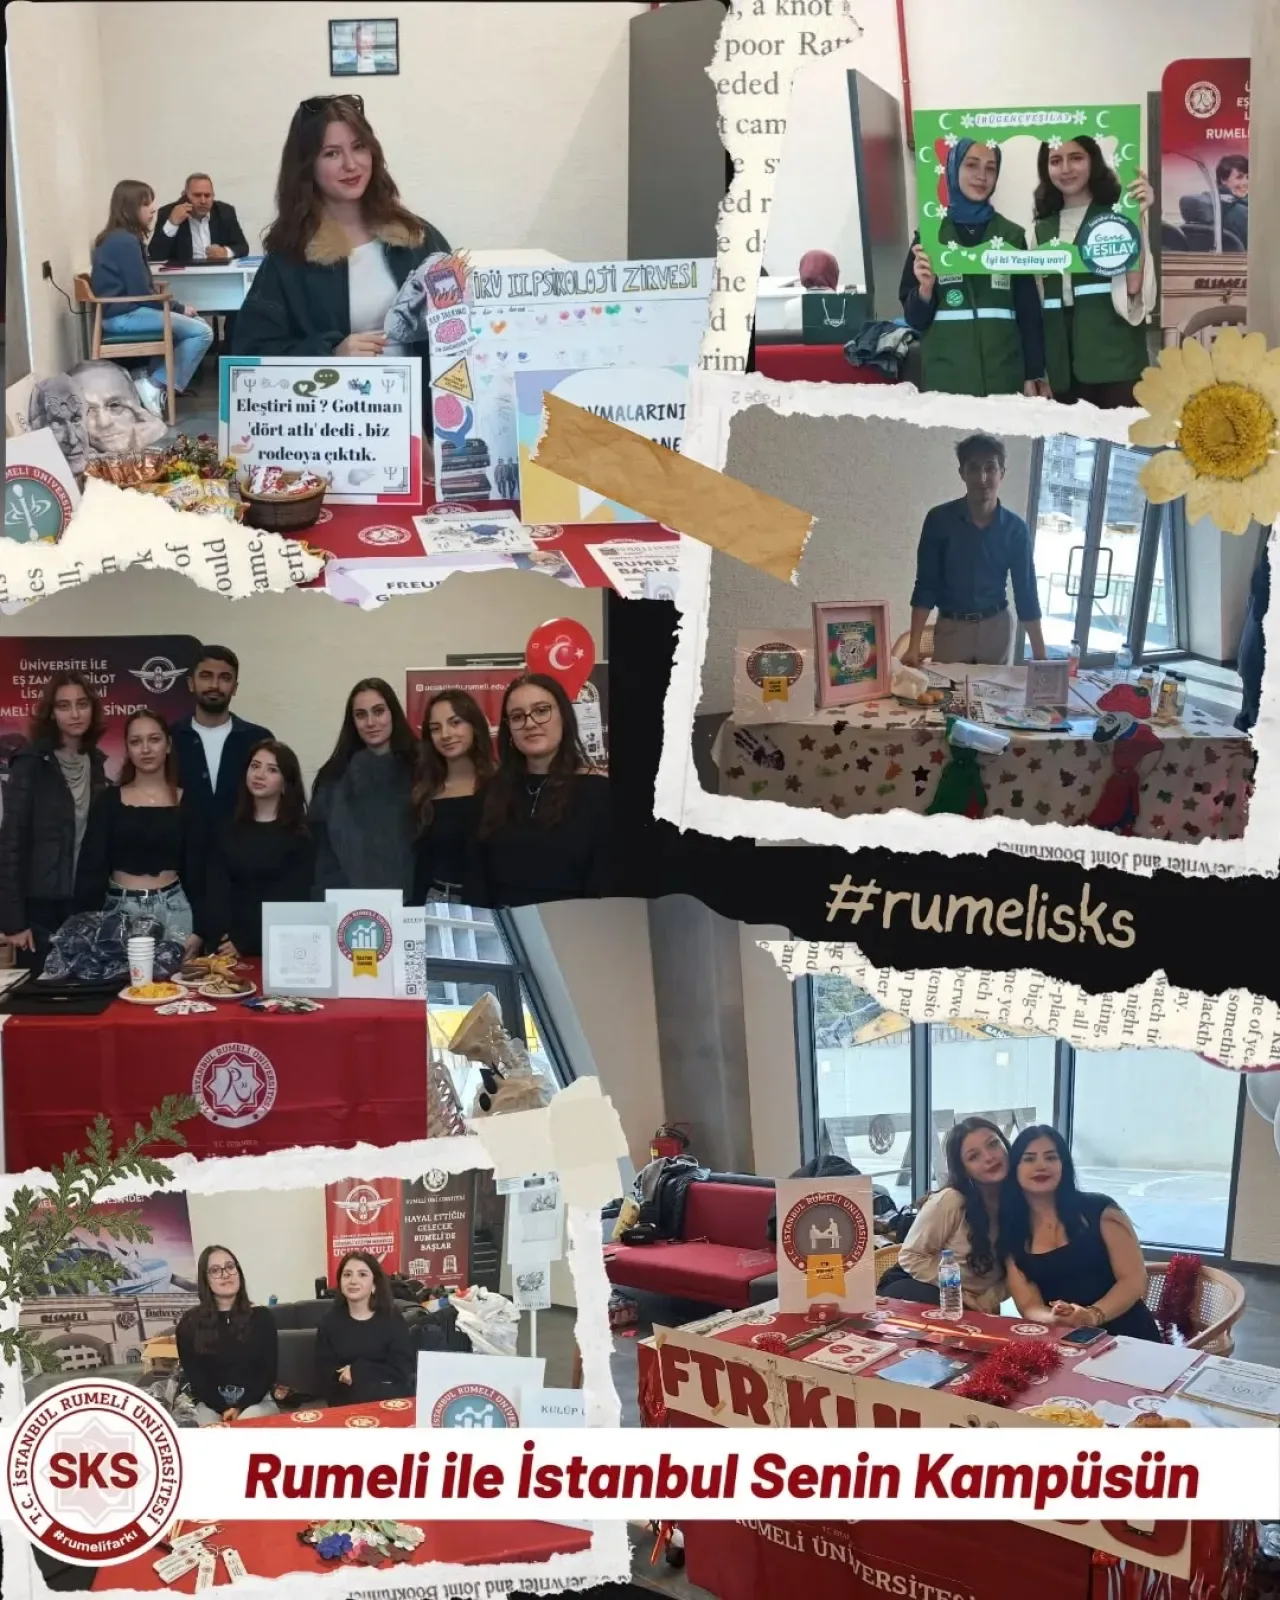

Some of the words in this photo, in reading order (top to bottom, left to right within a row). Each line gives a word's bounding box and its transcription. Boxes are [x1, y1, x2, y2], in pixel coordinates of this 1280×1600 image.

[622, 261, 698, 292] ZİRVESİ
[237, 398, 292, 416] Eleştiri
[296, 399, 316, 413] mi
[320, 399, 328, 413] ?
[332, 399, 403, 413] Gottman
[320, 422, 354, 437] dedi
[365, 422, 390, 437] biz
[258, 447, 321, 464] rodeoya
[324, 447, 376, 464] çıktık.
[387, 581, 440, 589] FREU
[20, 658, 88, 671] ÜNİVERSİTE
[90, 658, 108, 669] İLE
[13, 675, 26, 687] EŞ
[405, 1214, 431, 1223] HAYAL
[417, 1223, 453, 1232] GELECEK
[420, 1243, 451, 1252] BAŞLAR
[658, 1343, 771, 1426] FTR
[458, 1385, 493, 1398] RUMELİ
